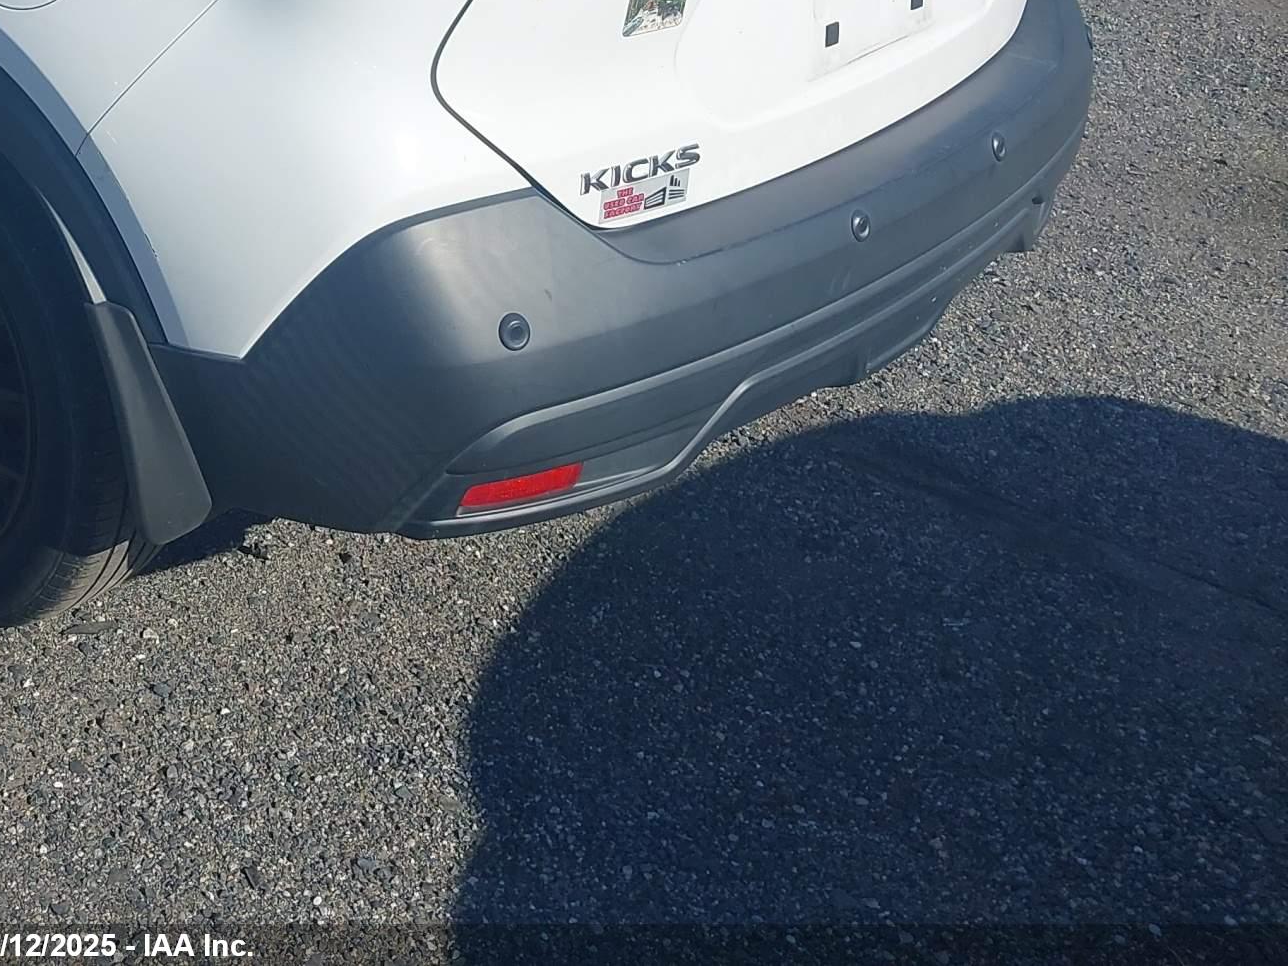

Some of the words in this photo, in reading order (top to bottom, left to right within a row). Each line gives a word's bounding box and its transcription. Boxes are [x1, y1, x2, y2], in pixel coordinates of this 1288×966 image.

[579, 143, 700, 196] KICKS
[617, 187, 634, 198] THE
[603, 198, 626, 210] USED
[626, 193, 645, 204] CAR
[603, 202, 643, 219] FACTORY
